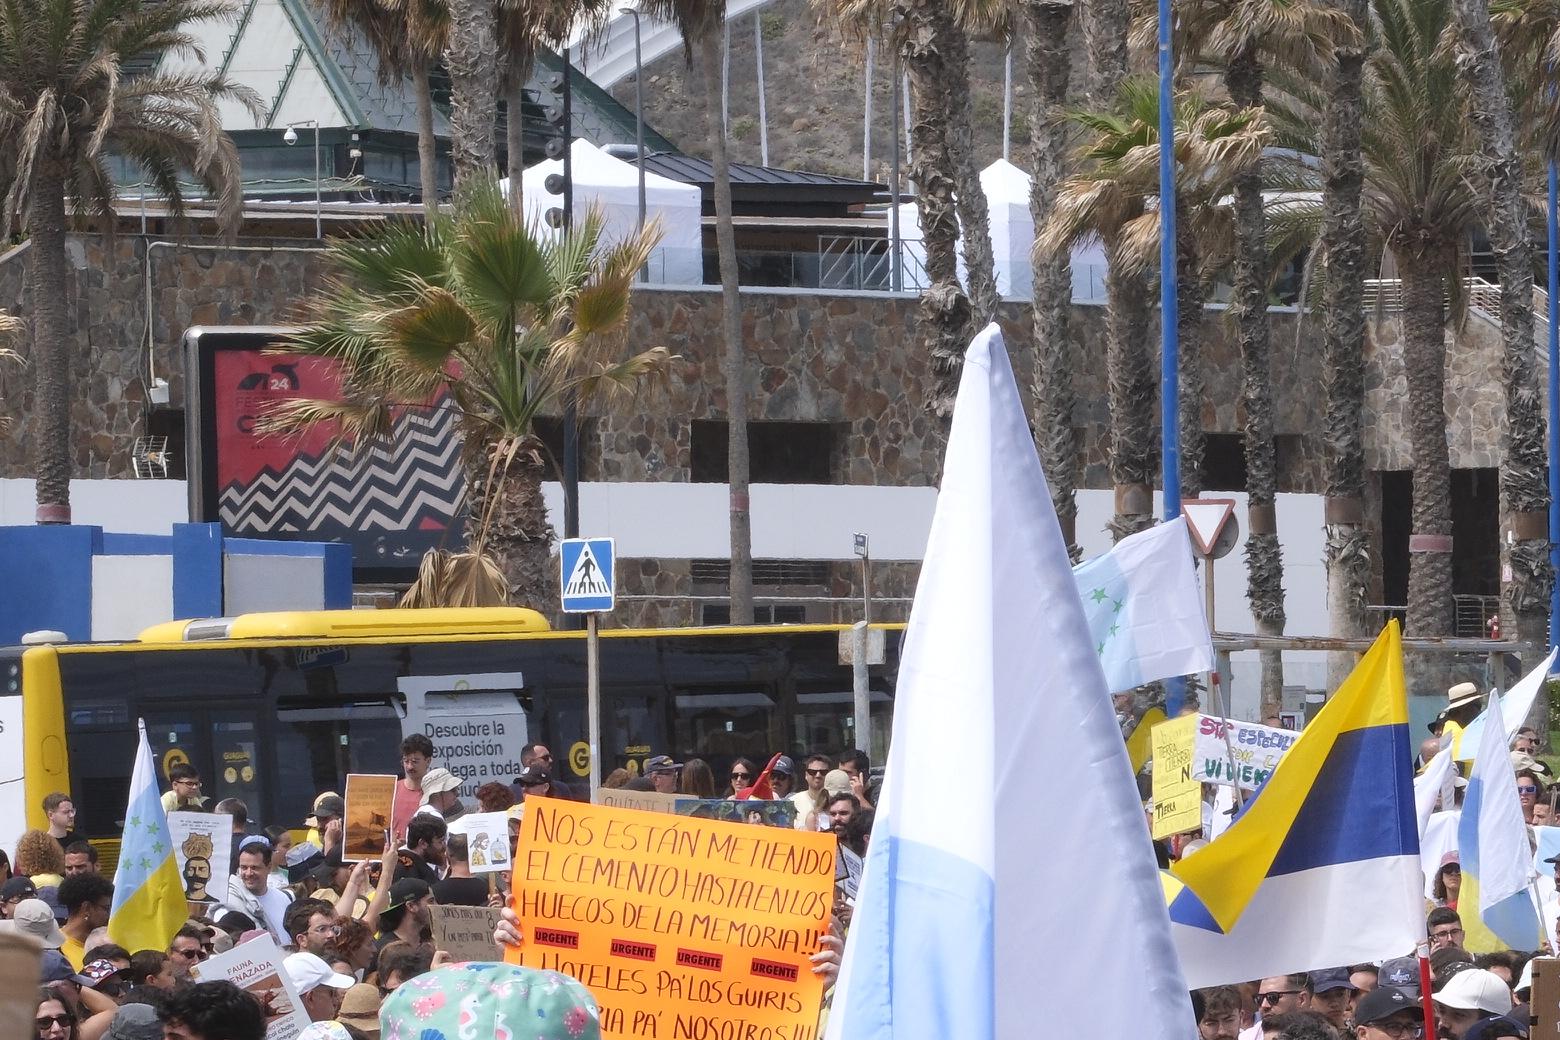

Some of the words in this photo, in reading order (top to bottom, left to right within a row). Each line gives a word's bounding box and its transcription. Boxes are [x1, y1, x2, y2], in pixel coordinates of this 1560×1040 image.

[270, 379, 289, 390] 24
[424, 721, 491, 738] Descubre
[493, 720, 505, 735] la
[431, 739, 503, 760] exposición
[480, 765, 488, 776] a
[491, 760, 520, 776] toda
[533, 806, 594, 848] NOS
[603, 822, 701, 858] ESTÁN
[707, 831, 833, 876] METIENDO
[526, 849, 555, 882] EL
[561, 852, 680, 898] CEMENTO
[684, 871, 752, 909] HASTA
[751, 882, 789, 914] EN
[789, 889, 830, 921] LOS
[521, 889, 615, 925] HUECOS
[622, 901, 648, 931] DE
[653, 909, 684, 935] LA
[535, 930, 578, 947] URGENTE
[611, 942, 655, 959] URGENTE
[677, 952, 721, 969] URGENTE
[752, 961, 797, 979] URGENTE
[227, 959, 254, 975] FAUNA
[229, 961, 273, 983] ENAZADA
[687, 975, 723, 1004] LOS
[727, 981, 802, 1013] GUIRIS
